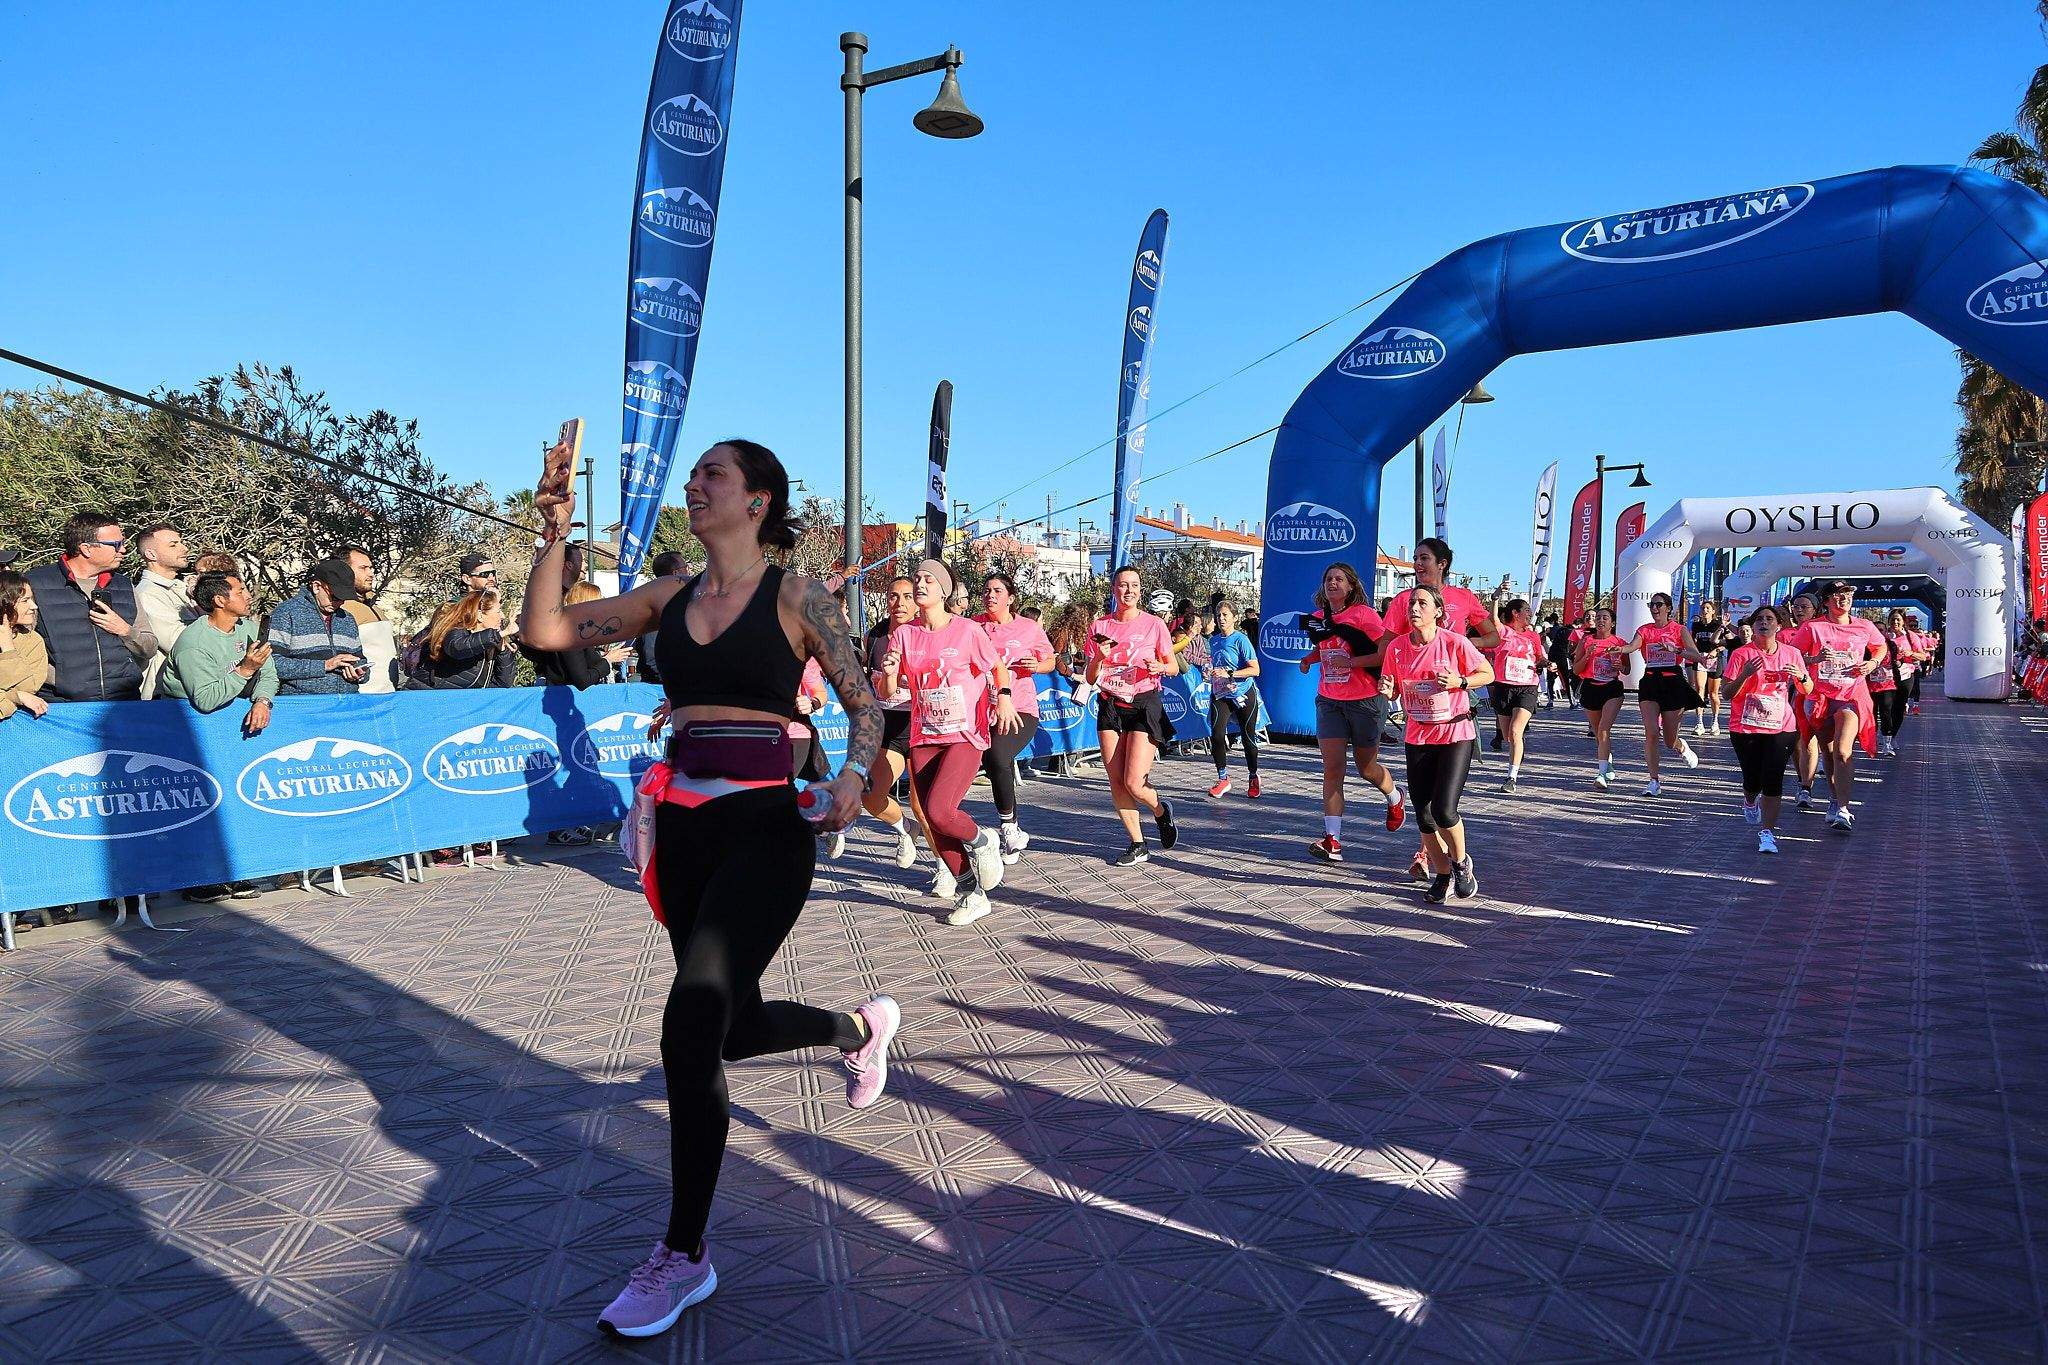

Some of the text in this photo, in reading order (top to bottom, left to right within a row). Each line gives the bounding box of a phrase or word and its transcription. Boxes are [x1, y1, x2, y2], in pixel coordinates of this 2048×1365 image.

[656, 111, 716, 144] ASTURIANA
[640, 200, 711, 238] ASTURIANA
[1577, 193, 1793, 250] ASTURIANA
[1619, 204, 1696, 221] CENTRAL
[1342, 349, 1437, 370] ASTURIANA
[1725, 502, 1880, 534] OYSHO
[1268, 522, 1349, 542] ASTURIANA
[1577, 502, 1592, 571] Santander
[1927, 528, 1979, 540] OYSHO
[1641, 540, 1683, 549] OYSHO
[1955, 588, 2004, 599] OYSHO
[1954, 646, 2003, 657] OYSHO
[932, 709, 950, 717] 016
[598, 734, 636, 743] CENTRAL
[455, 742, 547, 758] CENTRAL LECHERA
[276, 758, 392, 776] CENTRAL LECHERA
[437, 752, 555, 781] ASTURIANA
[56, 775, 198, 793] CENTRAL LECHERA
[254, 768, 402, 802] ASTURIANA
[25, 787, 209, 823] ASTURIANA
